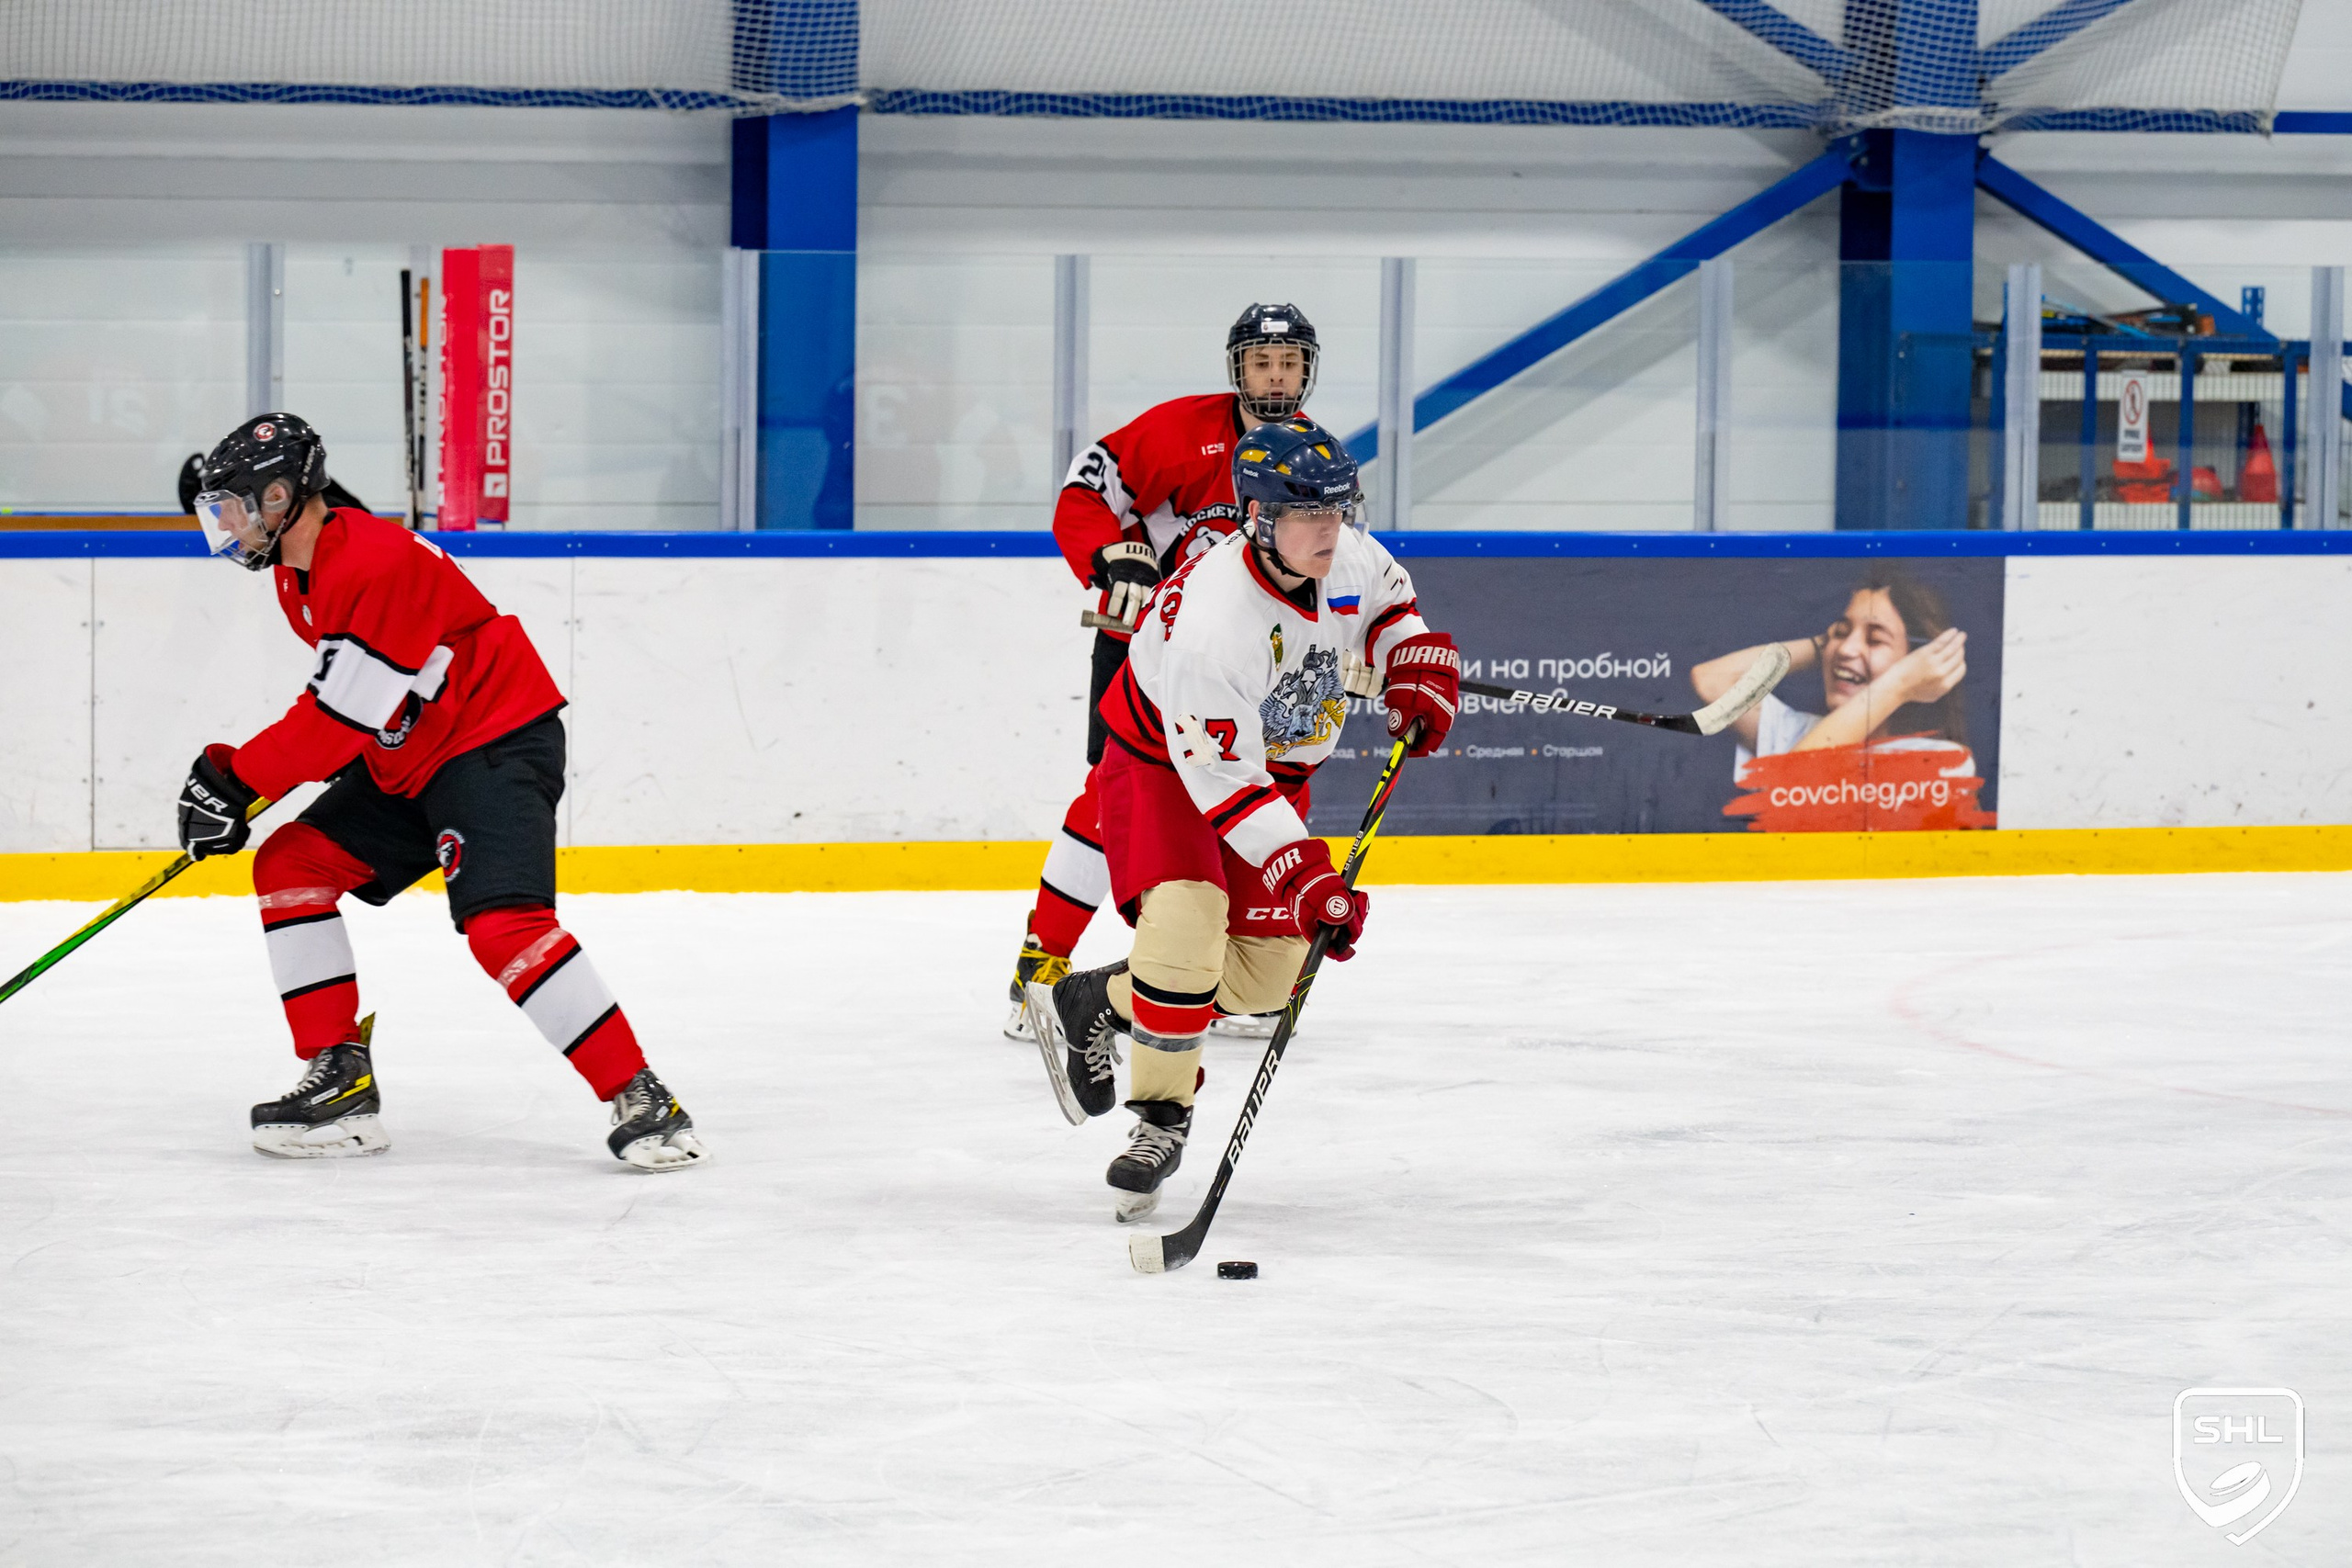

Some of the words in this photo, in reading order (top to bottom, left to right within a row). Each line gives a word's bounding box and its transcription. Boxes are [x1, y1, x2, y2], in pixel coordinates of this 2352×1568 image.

[486, 288, 511, 466] PROSTOR
[1077, 451, 1107, 489] 2
[1323, 481, 1351, 495] Reebok
[1179, 505, 1238, 537] HOCKEY
[1391, 645, 1460, 671] WARR
[1491, 659, 1529, 679] на
[1538, 651, 1671, 685] пробной
[1510, 690, 1618, 720] BAUER
[1466, 744, 1525, 760] Средняя
[1542, 743, 1604, 760] Старшая
[1343, 830, 1364, 872] BAUER
[1245, 907, 1292, 921] CC
[1227, 1048, 1281, 1173] BAUER
